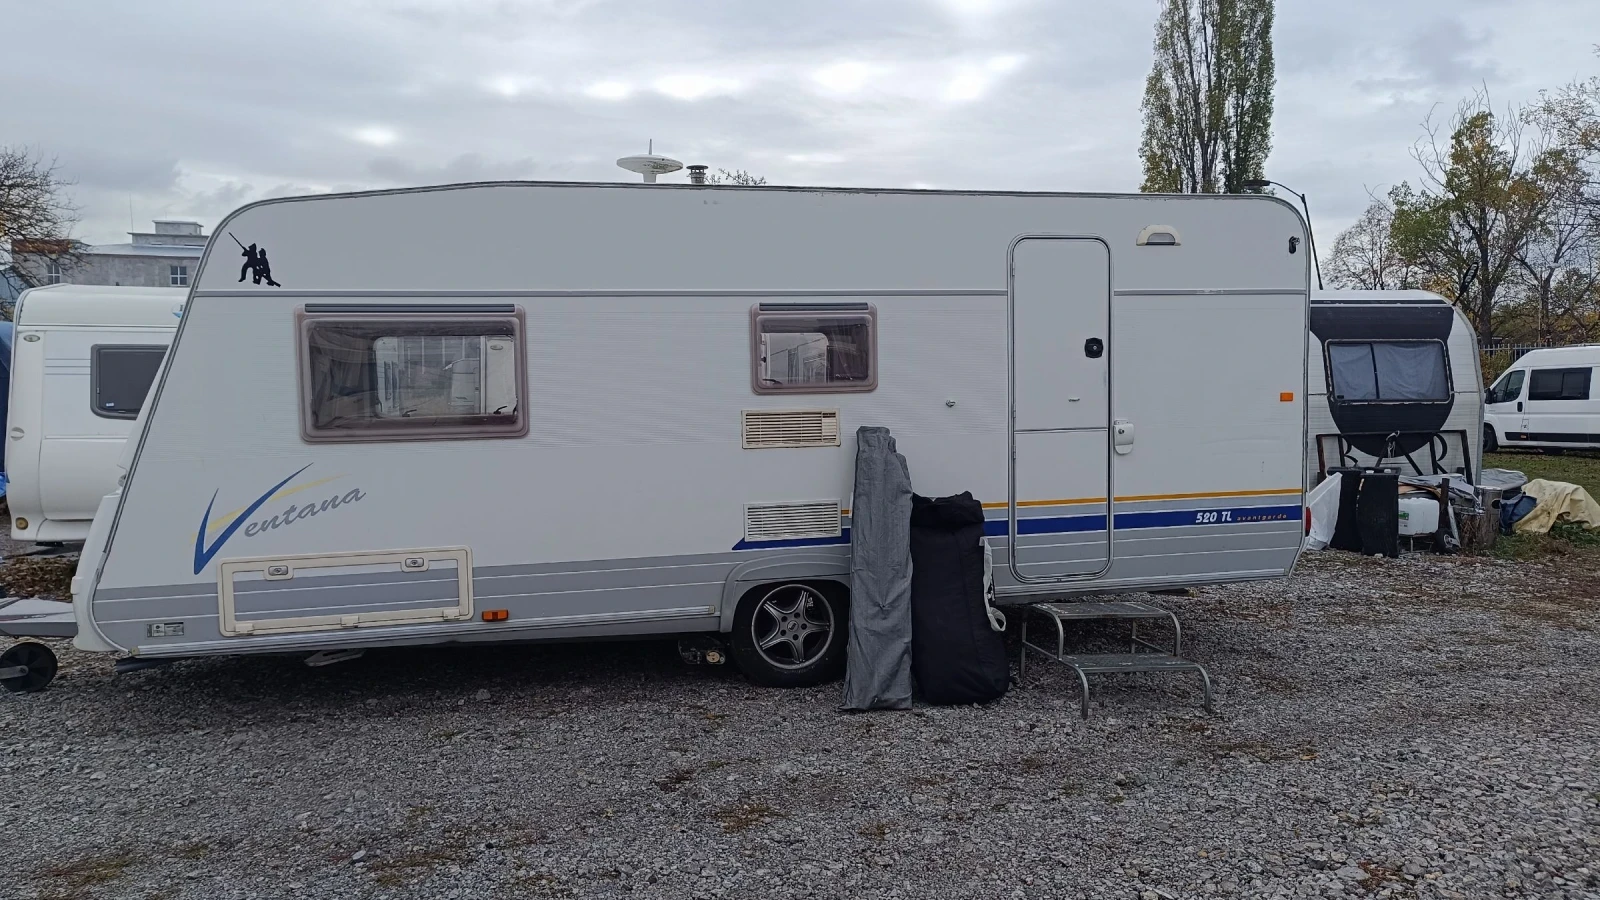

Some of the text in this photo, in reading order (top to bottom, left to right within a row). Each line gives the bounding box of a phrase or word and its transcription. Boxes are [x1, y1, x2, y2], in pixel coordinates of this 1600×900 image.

[193, 461, 367, 576] Ventana
[1195, 511, 1218, 523] 520
[1221, 511, 1232, 522] TL
